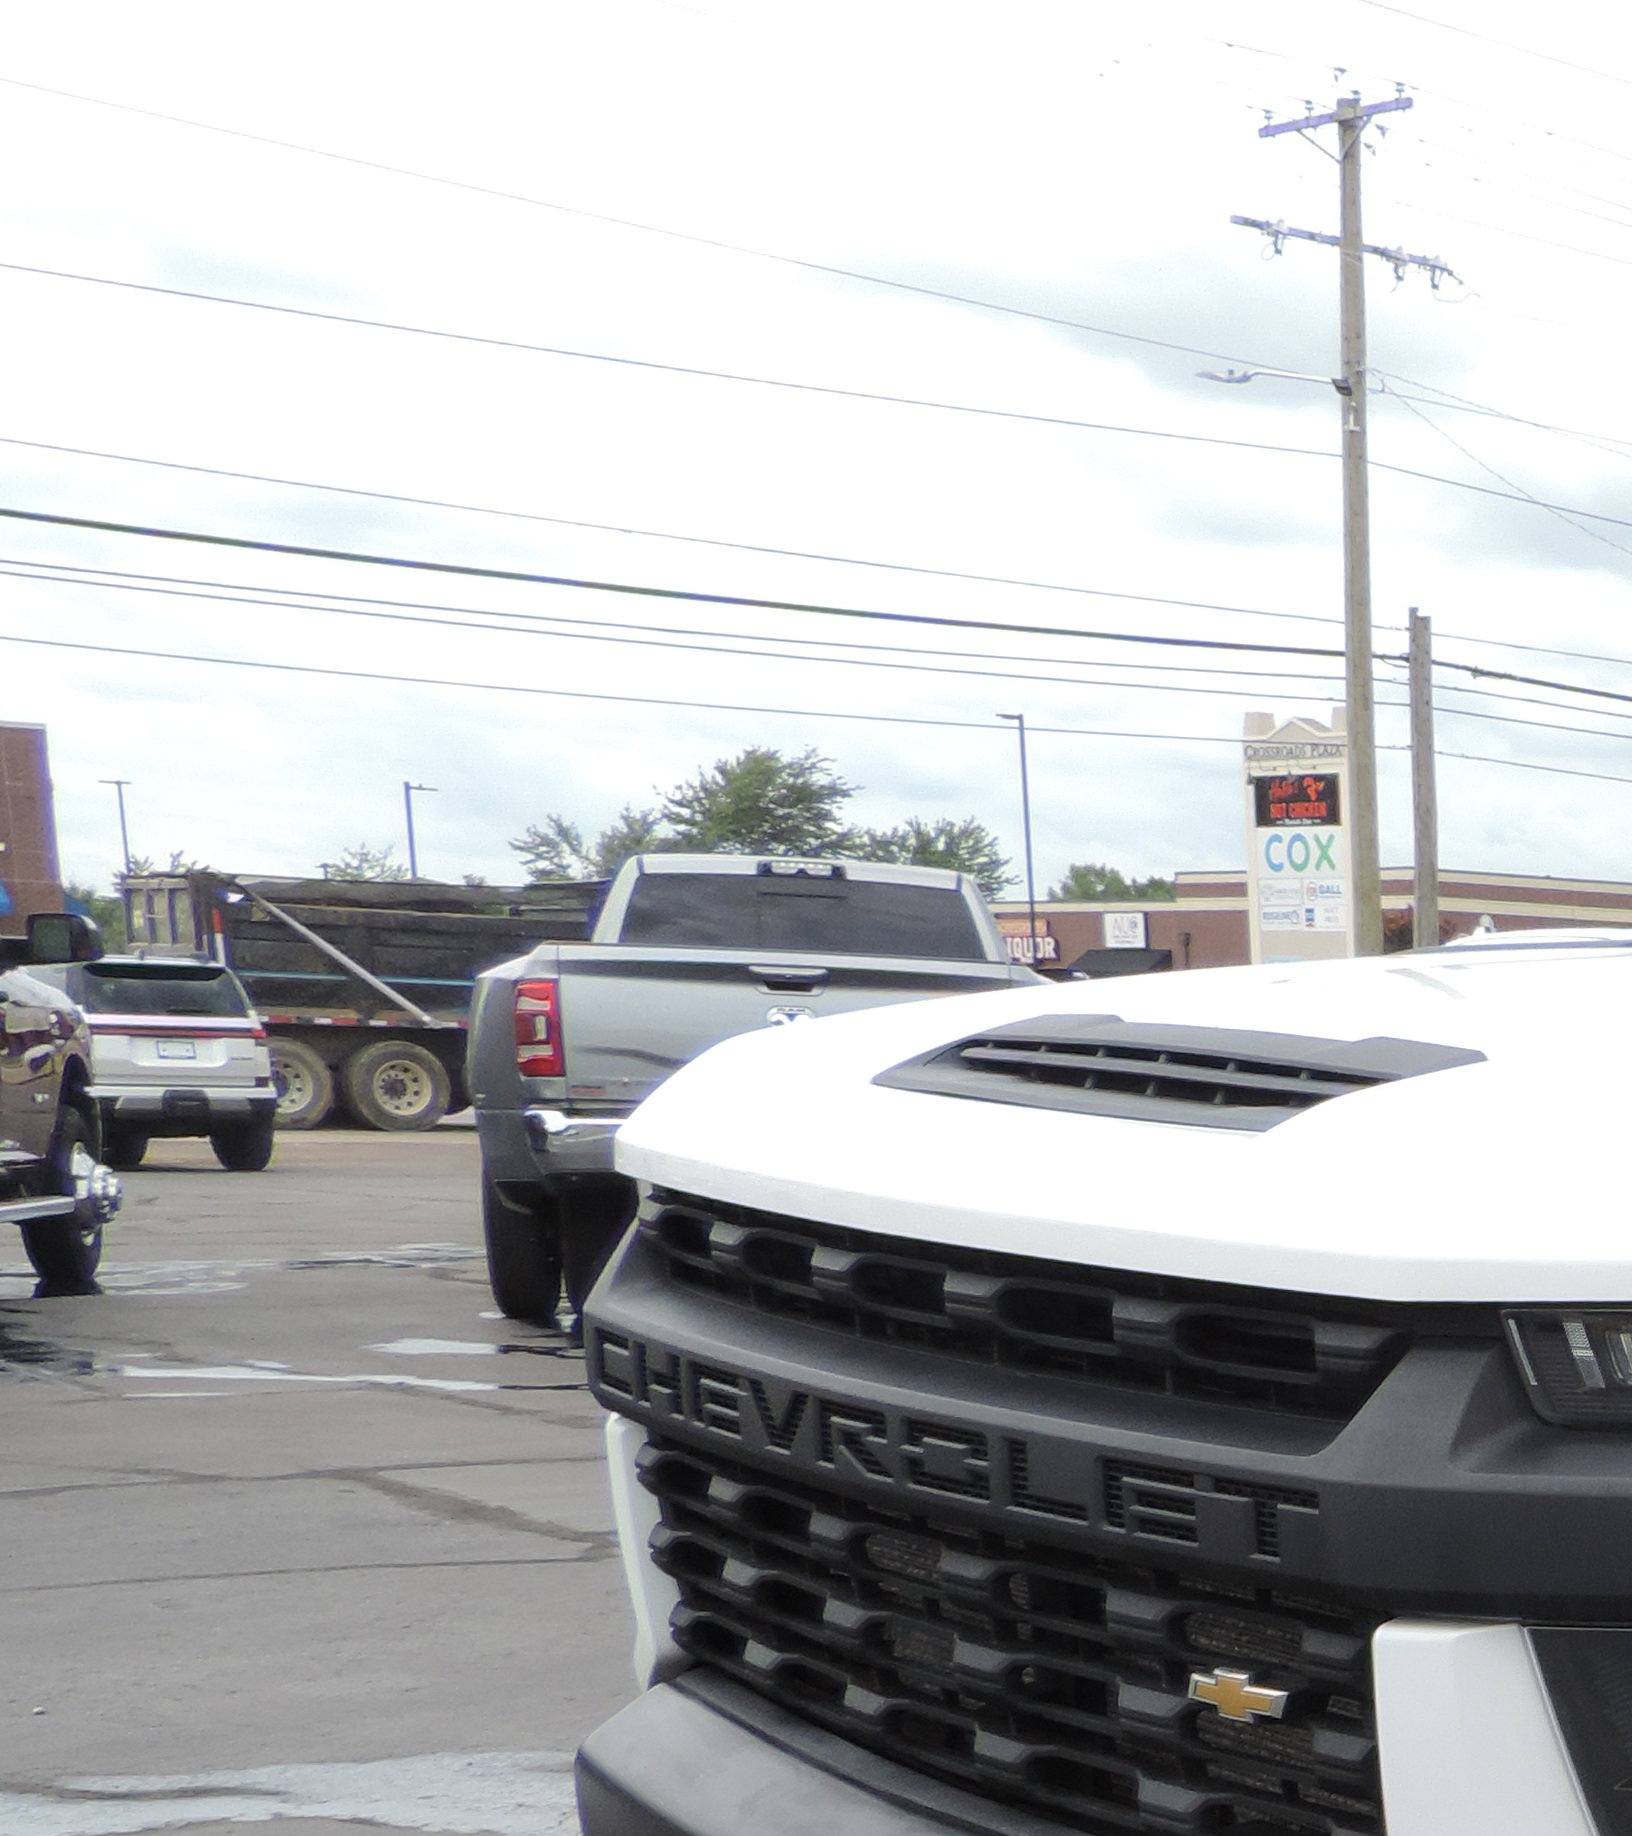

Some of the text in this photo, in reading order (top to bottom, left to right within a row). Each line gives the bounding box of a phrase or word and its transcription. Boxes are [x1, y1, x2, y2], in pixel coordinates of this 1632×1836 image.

[1310, 744, 1344, 758] PLAZA
[1264, 833, 1336, 872] COX
[1004, 936, 1057, 964] IQUOR
[594, 1325, 1321, 1561] CHEVROLET
